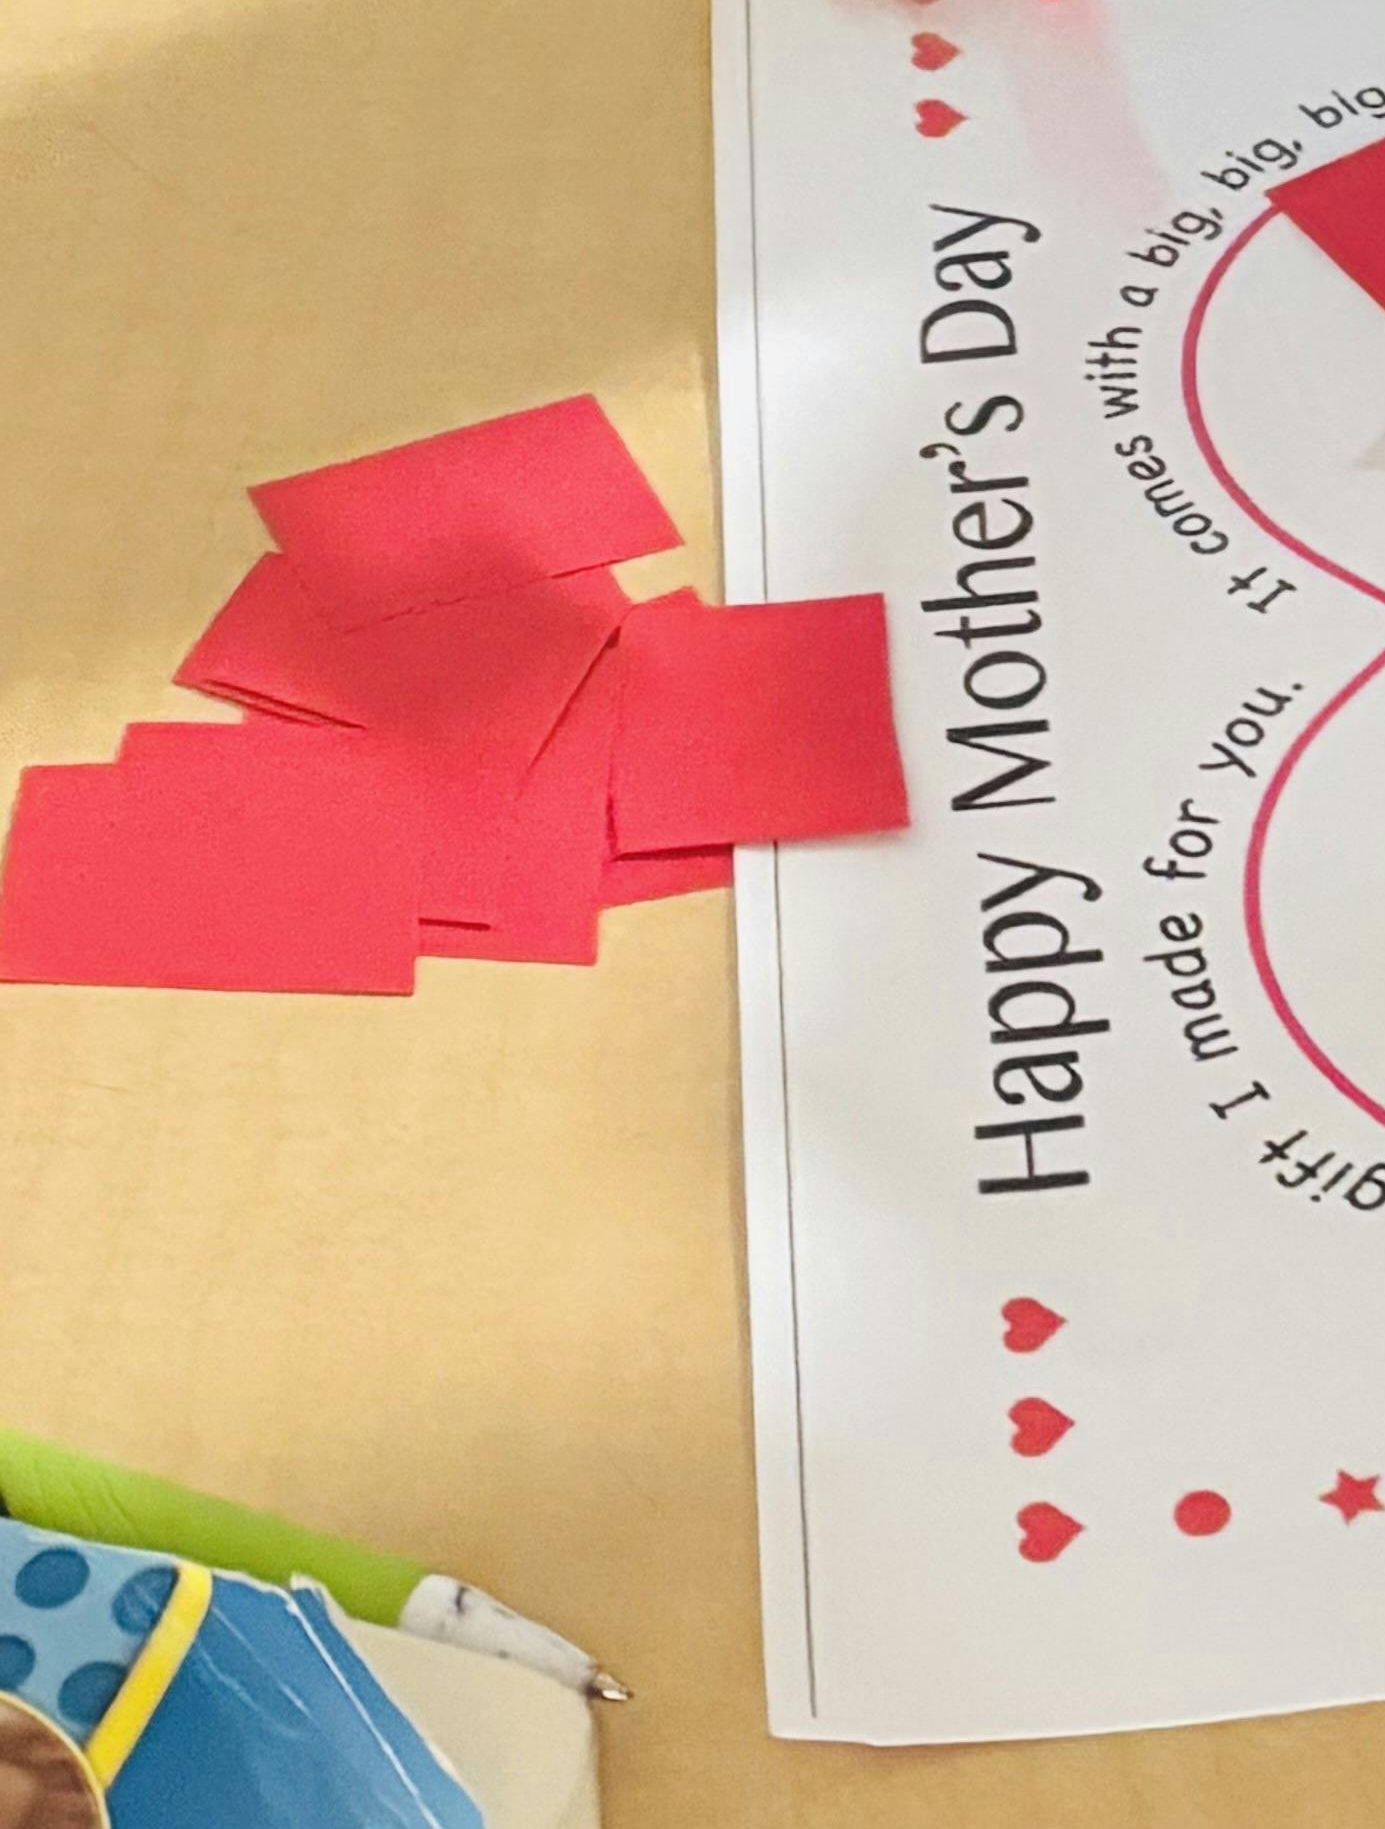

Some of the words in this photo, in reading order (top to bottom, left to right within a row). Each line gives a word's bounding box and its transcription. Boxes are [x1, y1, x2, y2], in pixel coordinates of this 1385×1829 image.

[1198, 136, 1305, 193] big,
[918, 202, 1044, 366] Day
[1125, 205, 1226, 270] big,
[1117, 283, 1161, 310] a
[1082, 324, 1145, 421] with
[1112, 432, 1231, 557] comes
[917, 392, 1058, 814] Mother's
[1225, 564, 1299, 616] It
[1196, 681, 1305, 780] you.
[1140, 796, 1221, 883] for
[972, 850, 1113, 1197] Happy
[1141, 910, 1241, 1064] made
[1206, 1078, 1273, 1122] I
